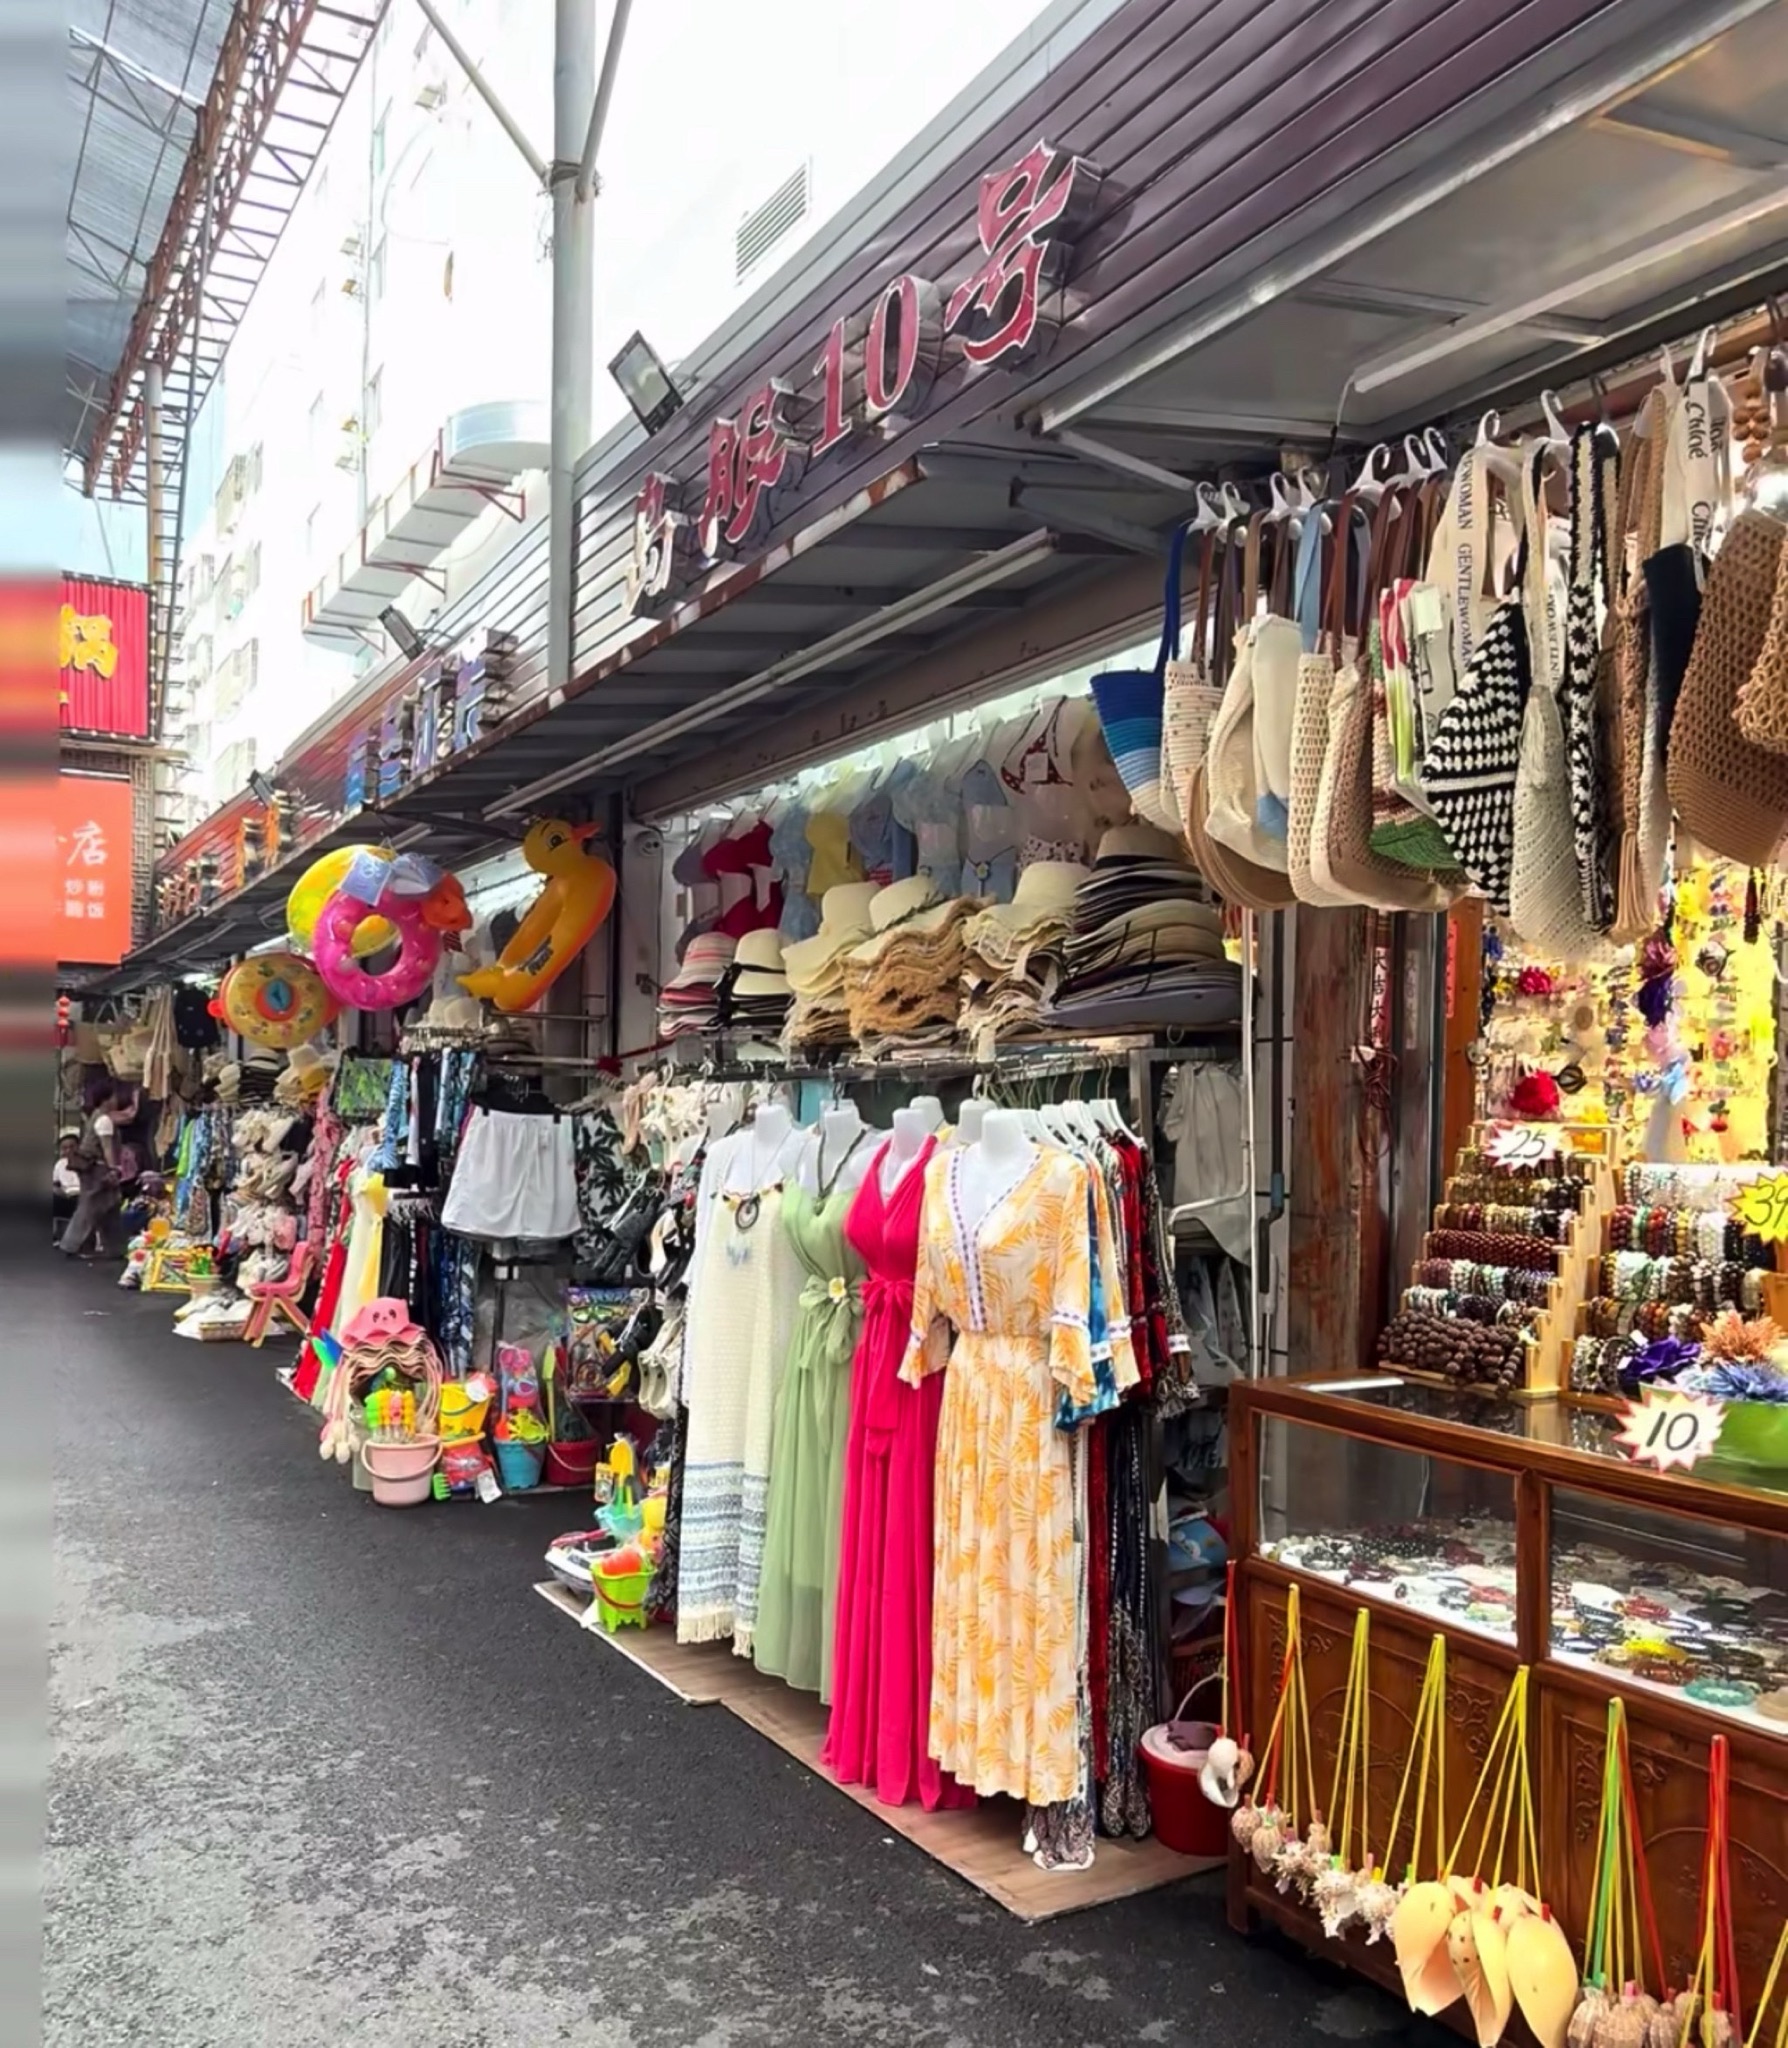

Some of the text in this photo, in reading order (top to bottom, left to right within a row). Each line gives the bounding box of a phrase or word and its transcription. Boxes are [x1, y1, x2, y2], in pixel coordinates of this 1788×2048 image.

[57, 819, 108, 866] 店
[1503, 1129, 1547, 1159] 25
[1744, 1183, 1788, 1229] 39
[1646, 1410, 1699, 1451] 10
